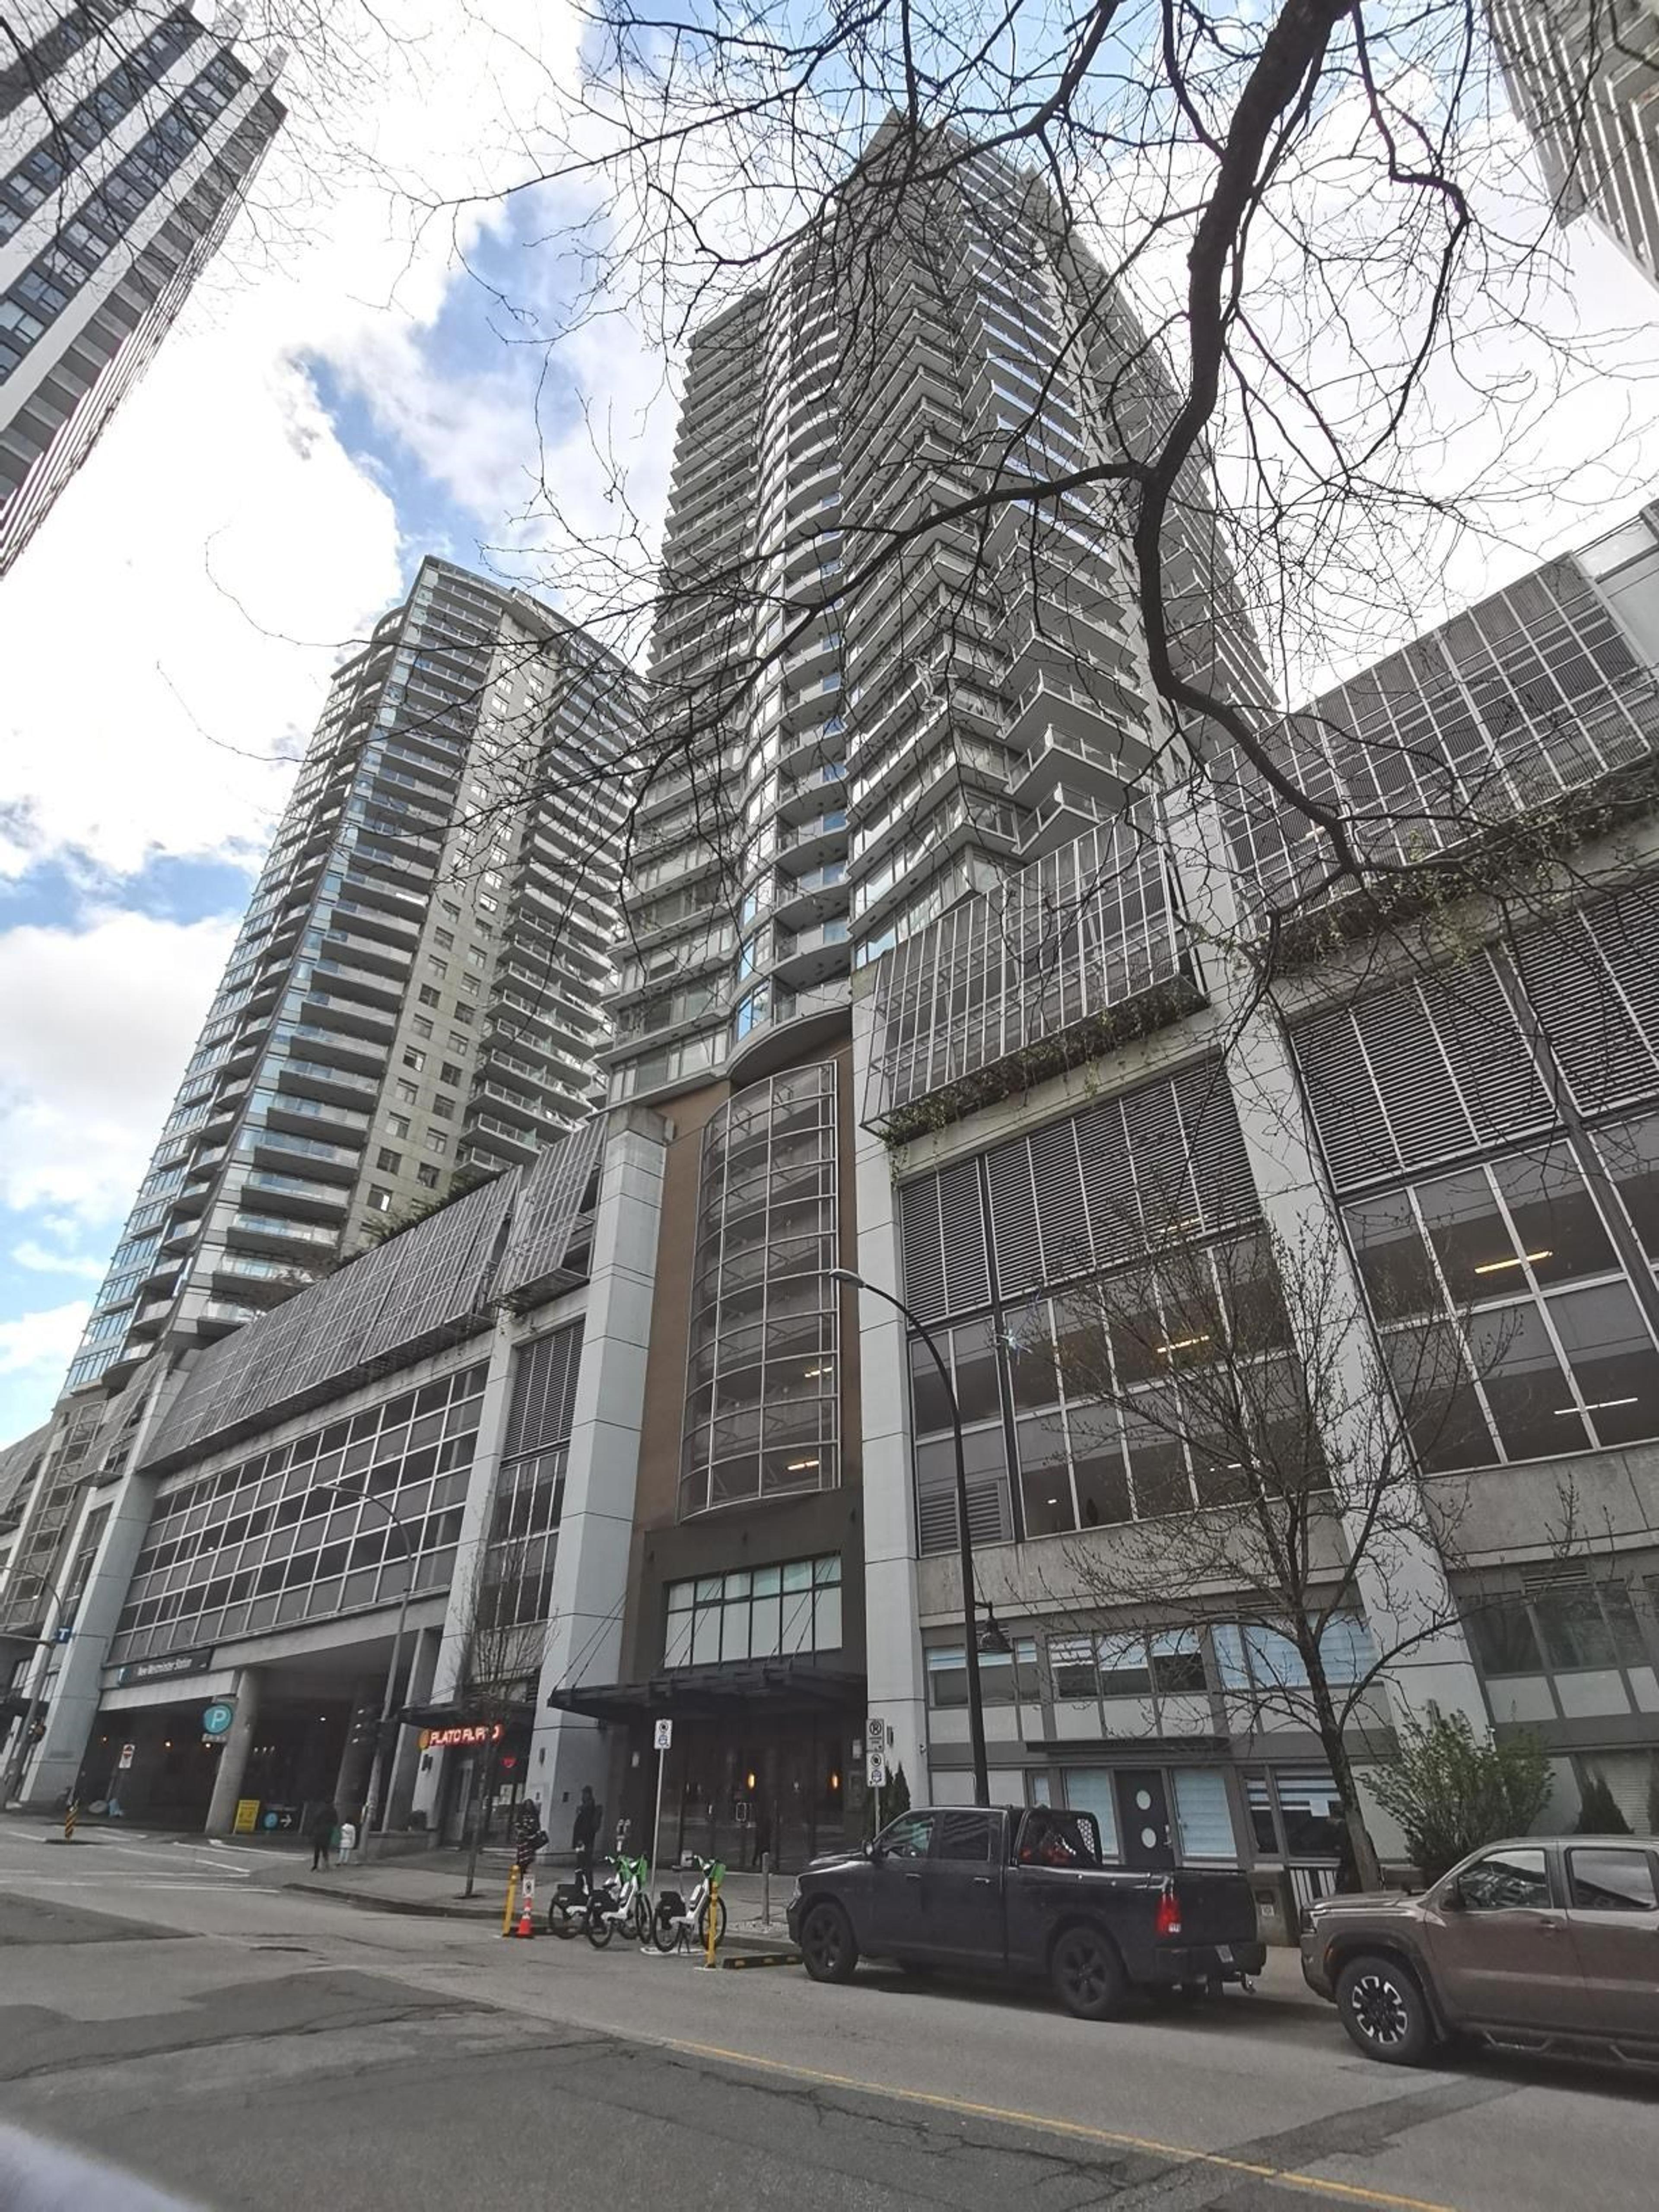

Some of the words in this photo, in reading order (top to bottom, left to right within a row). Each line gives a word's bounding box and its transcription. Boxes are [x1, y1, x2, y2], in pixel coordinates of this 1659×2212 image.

[59, 1627, 70, 1640] T
[211, 1710, 226, 1728] P
[429, 1728, 461, 1745] PLATO
